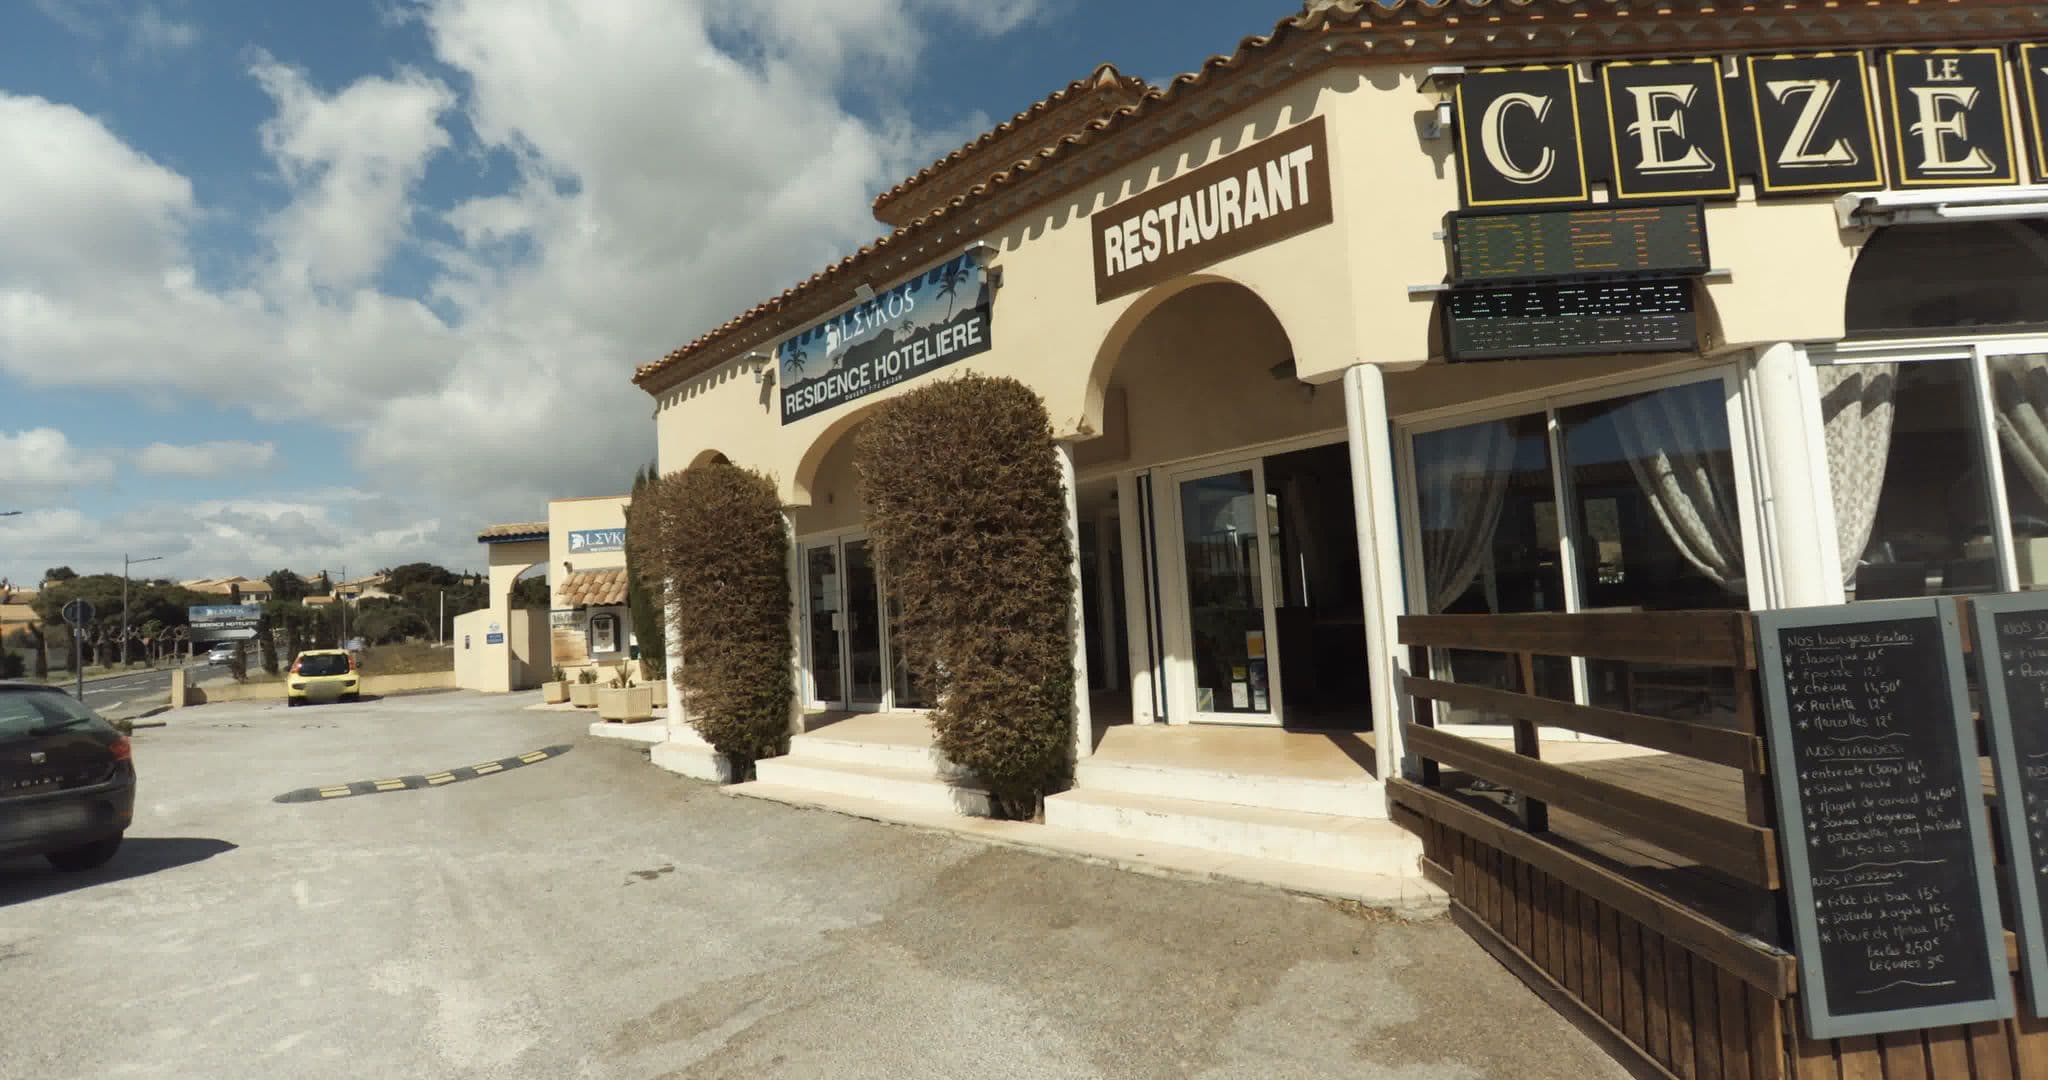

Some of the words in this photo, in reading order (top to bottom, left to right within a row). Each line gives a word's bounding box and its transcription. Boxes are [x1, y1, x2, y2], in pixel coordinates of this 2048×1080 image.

[1925, 58, 1963, 81] LE
[1104, 144, 1313, 277] RESTAURANT
[785, 363, 871, 415] RESIDENCE
[875, 317, 982, 380] HOTELIERE
